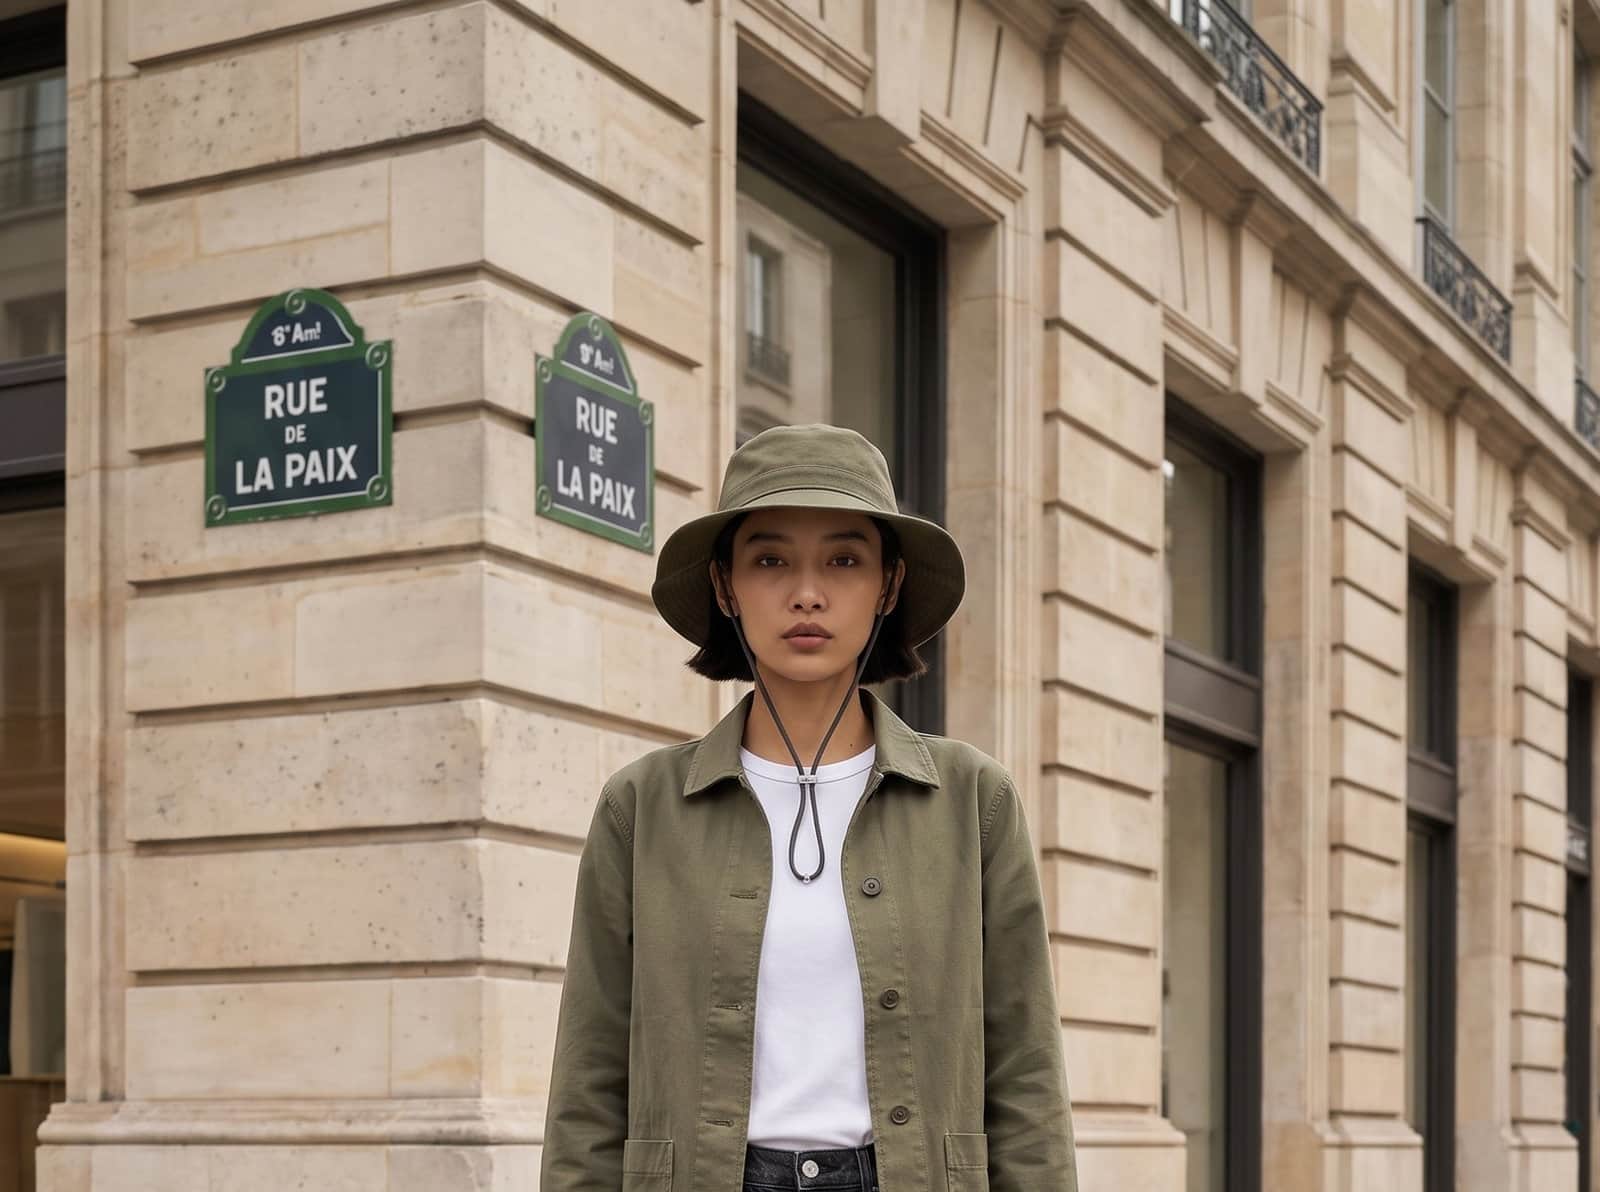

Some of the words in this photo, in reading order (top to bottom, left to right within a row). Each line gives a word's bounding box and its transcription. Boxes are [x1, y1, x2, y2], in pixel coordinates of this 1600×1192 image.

[264, 377, 328, 420] RUE
[576, 396, 618, 445] RUE
[285, 424, 306, 444] DE
[589, 444, 604, 466] DE
[235, 457, 274, 495] LA
[285, 445, 357, 488] PAIX
[557, 459, 584, 501] LA
[590, 471, 636, 520] PAIX
